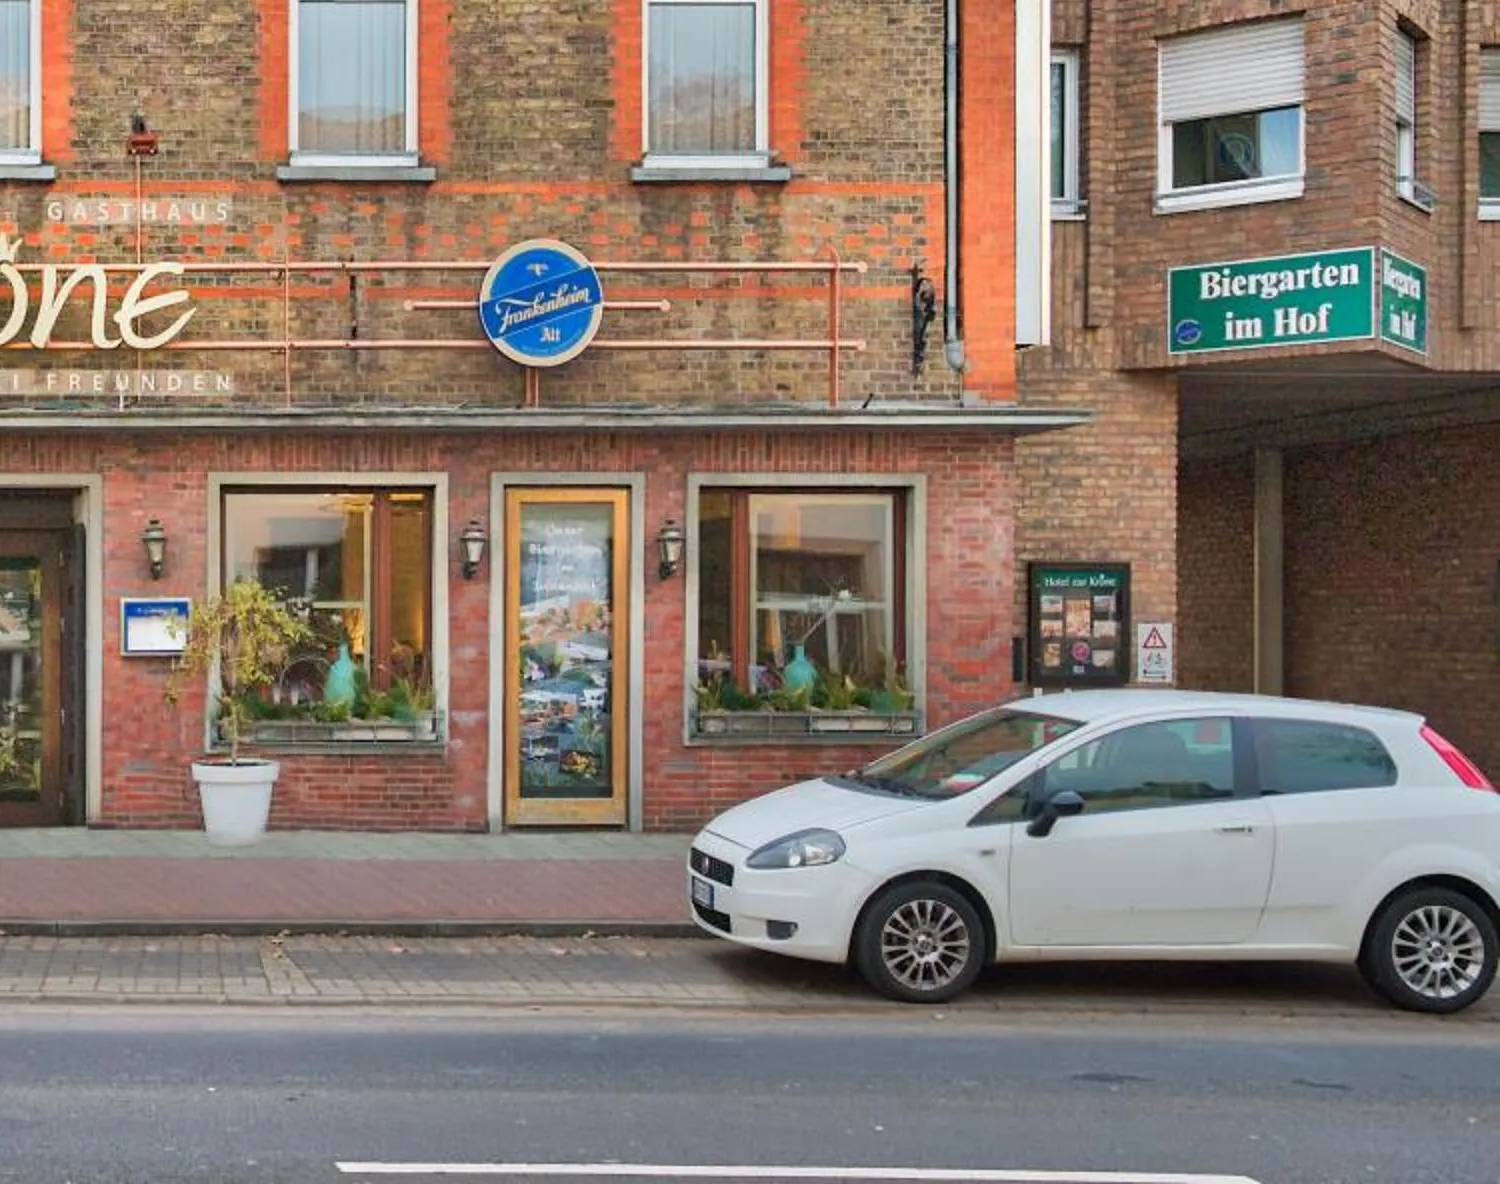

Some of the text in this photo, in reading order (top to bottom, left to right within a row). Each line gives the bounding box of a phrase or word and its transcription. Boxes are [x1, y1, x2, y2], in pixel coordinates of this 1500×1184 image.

[46, 200, 228, 222] GASTHAUS
[1200, 261, 1360, 300] Biergarten
[495, 283, 593, 334] Frankenheim
[1224, 311, 1263, 341] im
[1273, 303, 1333, 337] Hof
[46, 372, 233, 392] FREUNDEN
